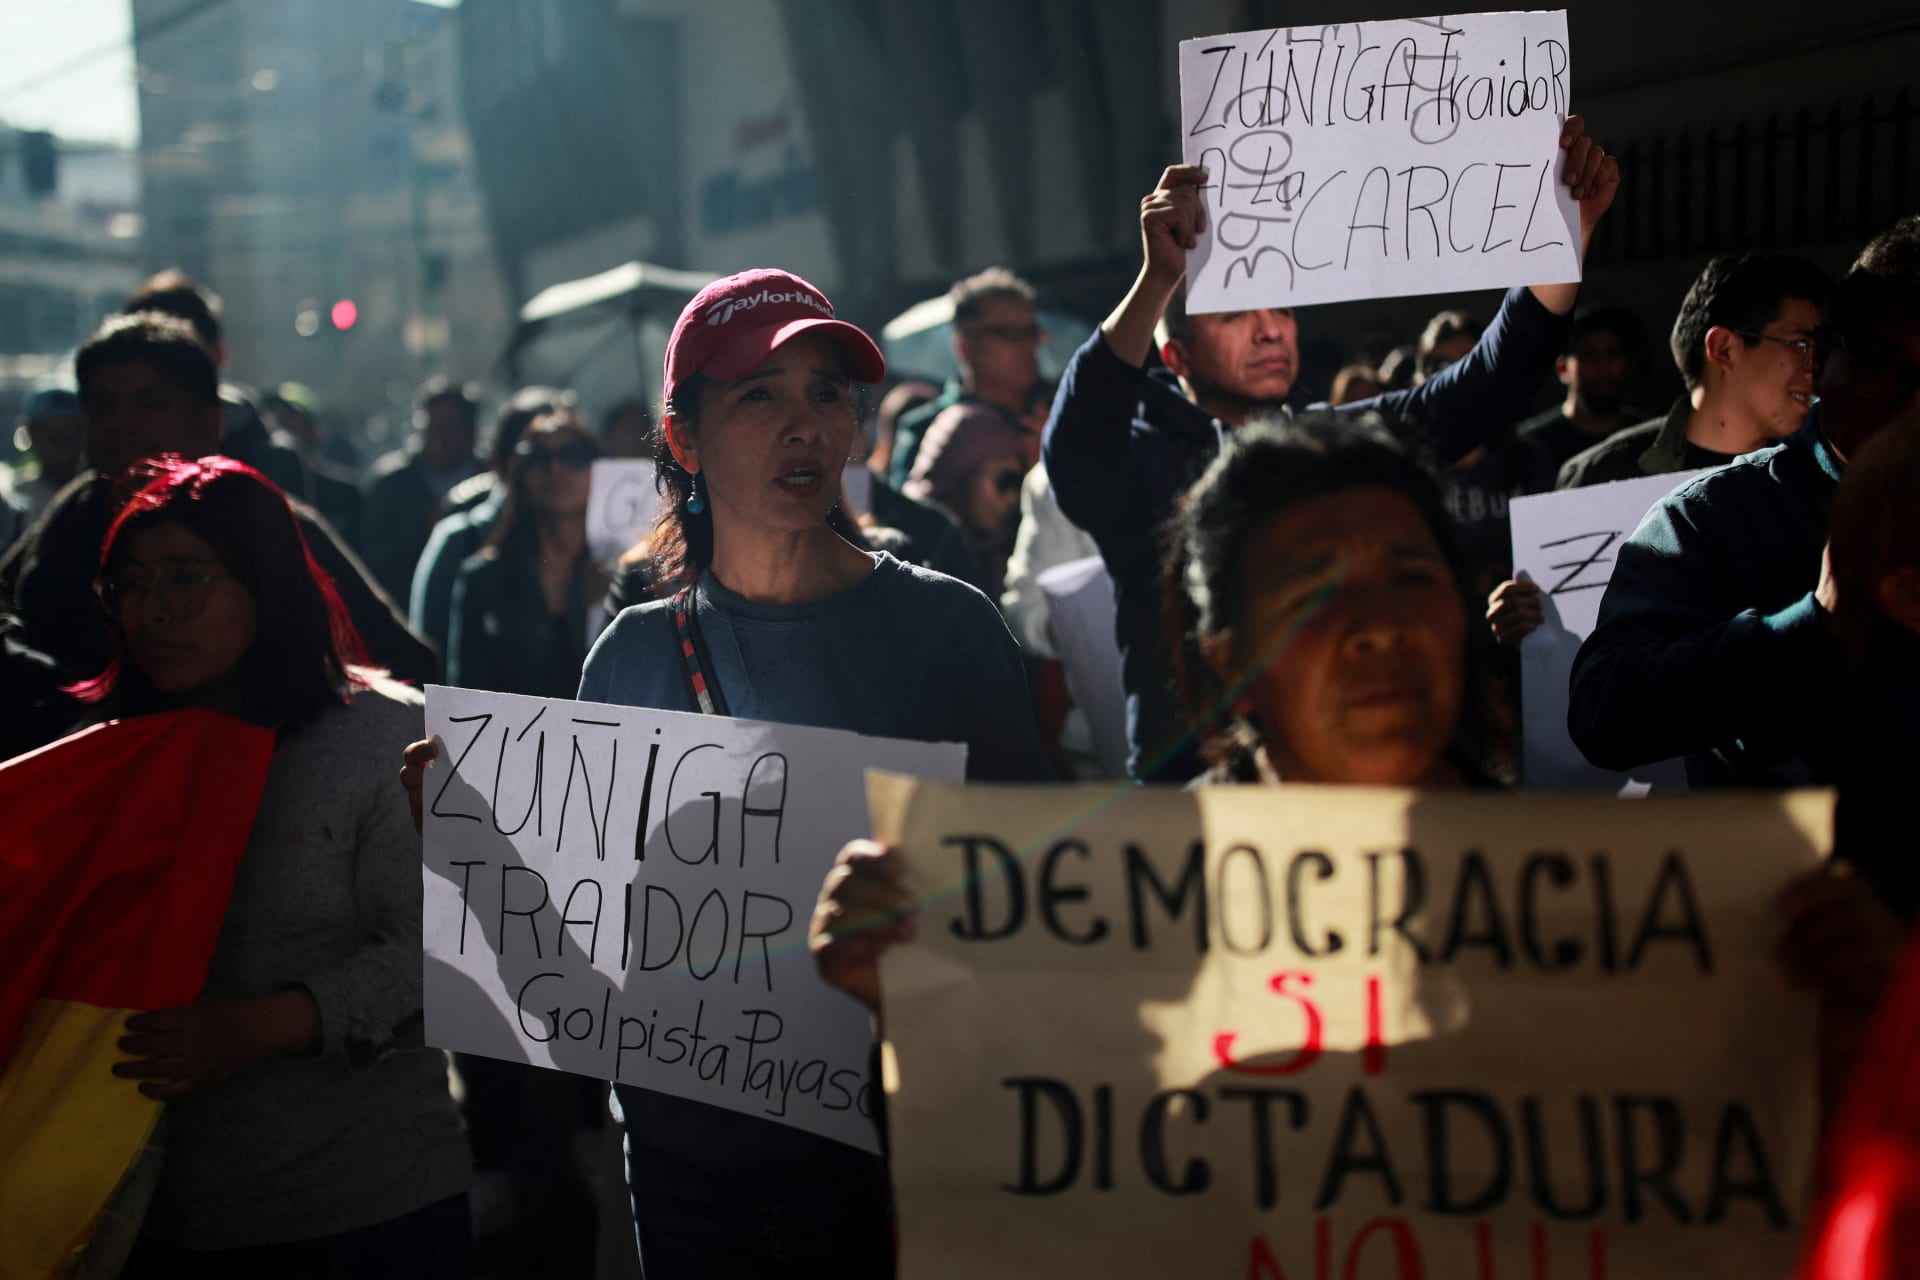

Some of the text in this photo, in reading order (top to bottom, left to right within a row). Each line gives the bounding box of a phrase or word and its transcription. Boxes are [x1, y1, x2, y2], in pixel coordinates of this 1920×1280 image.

[1292, 159, 1564, 271] CARCEL
[449, 860, 793, 992] TRAIDOR
[938, 831, 1716, 976] DEMOCRACIA
[516, 972, 728, 1085] Golpista
[1211, 970, 1388, 1078] SI
[997, 1074, 1791, 1231] DICTADURA
